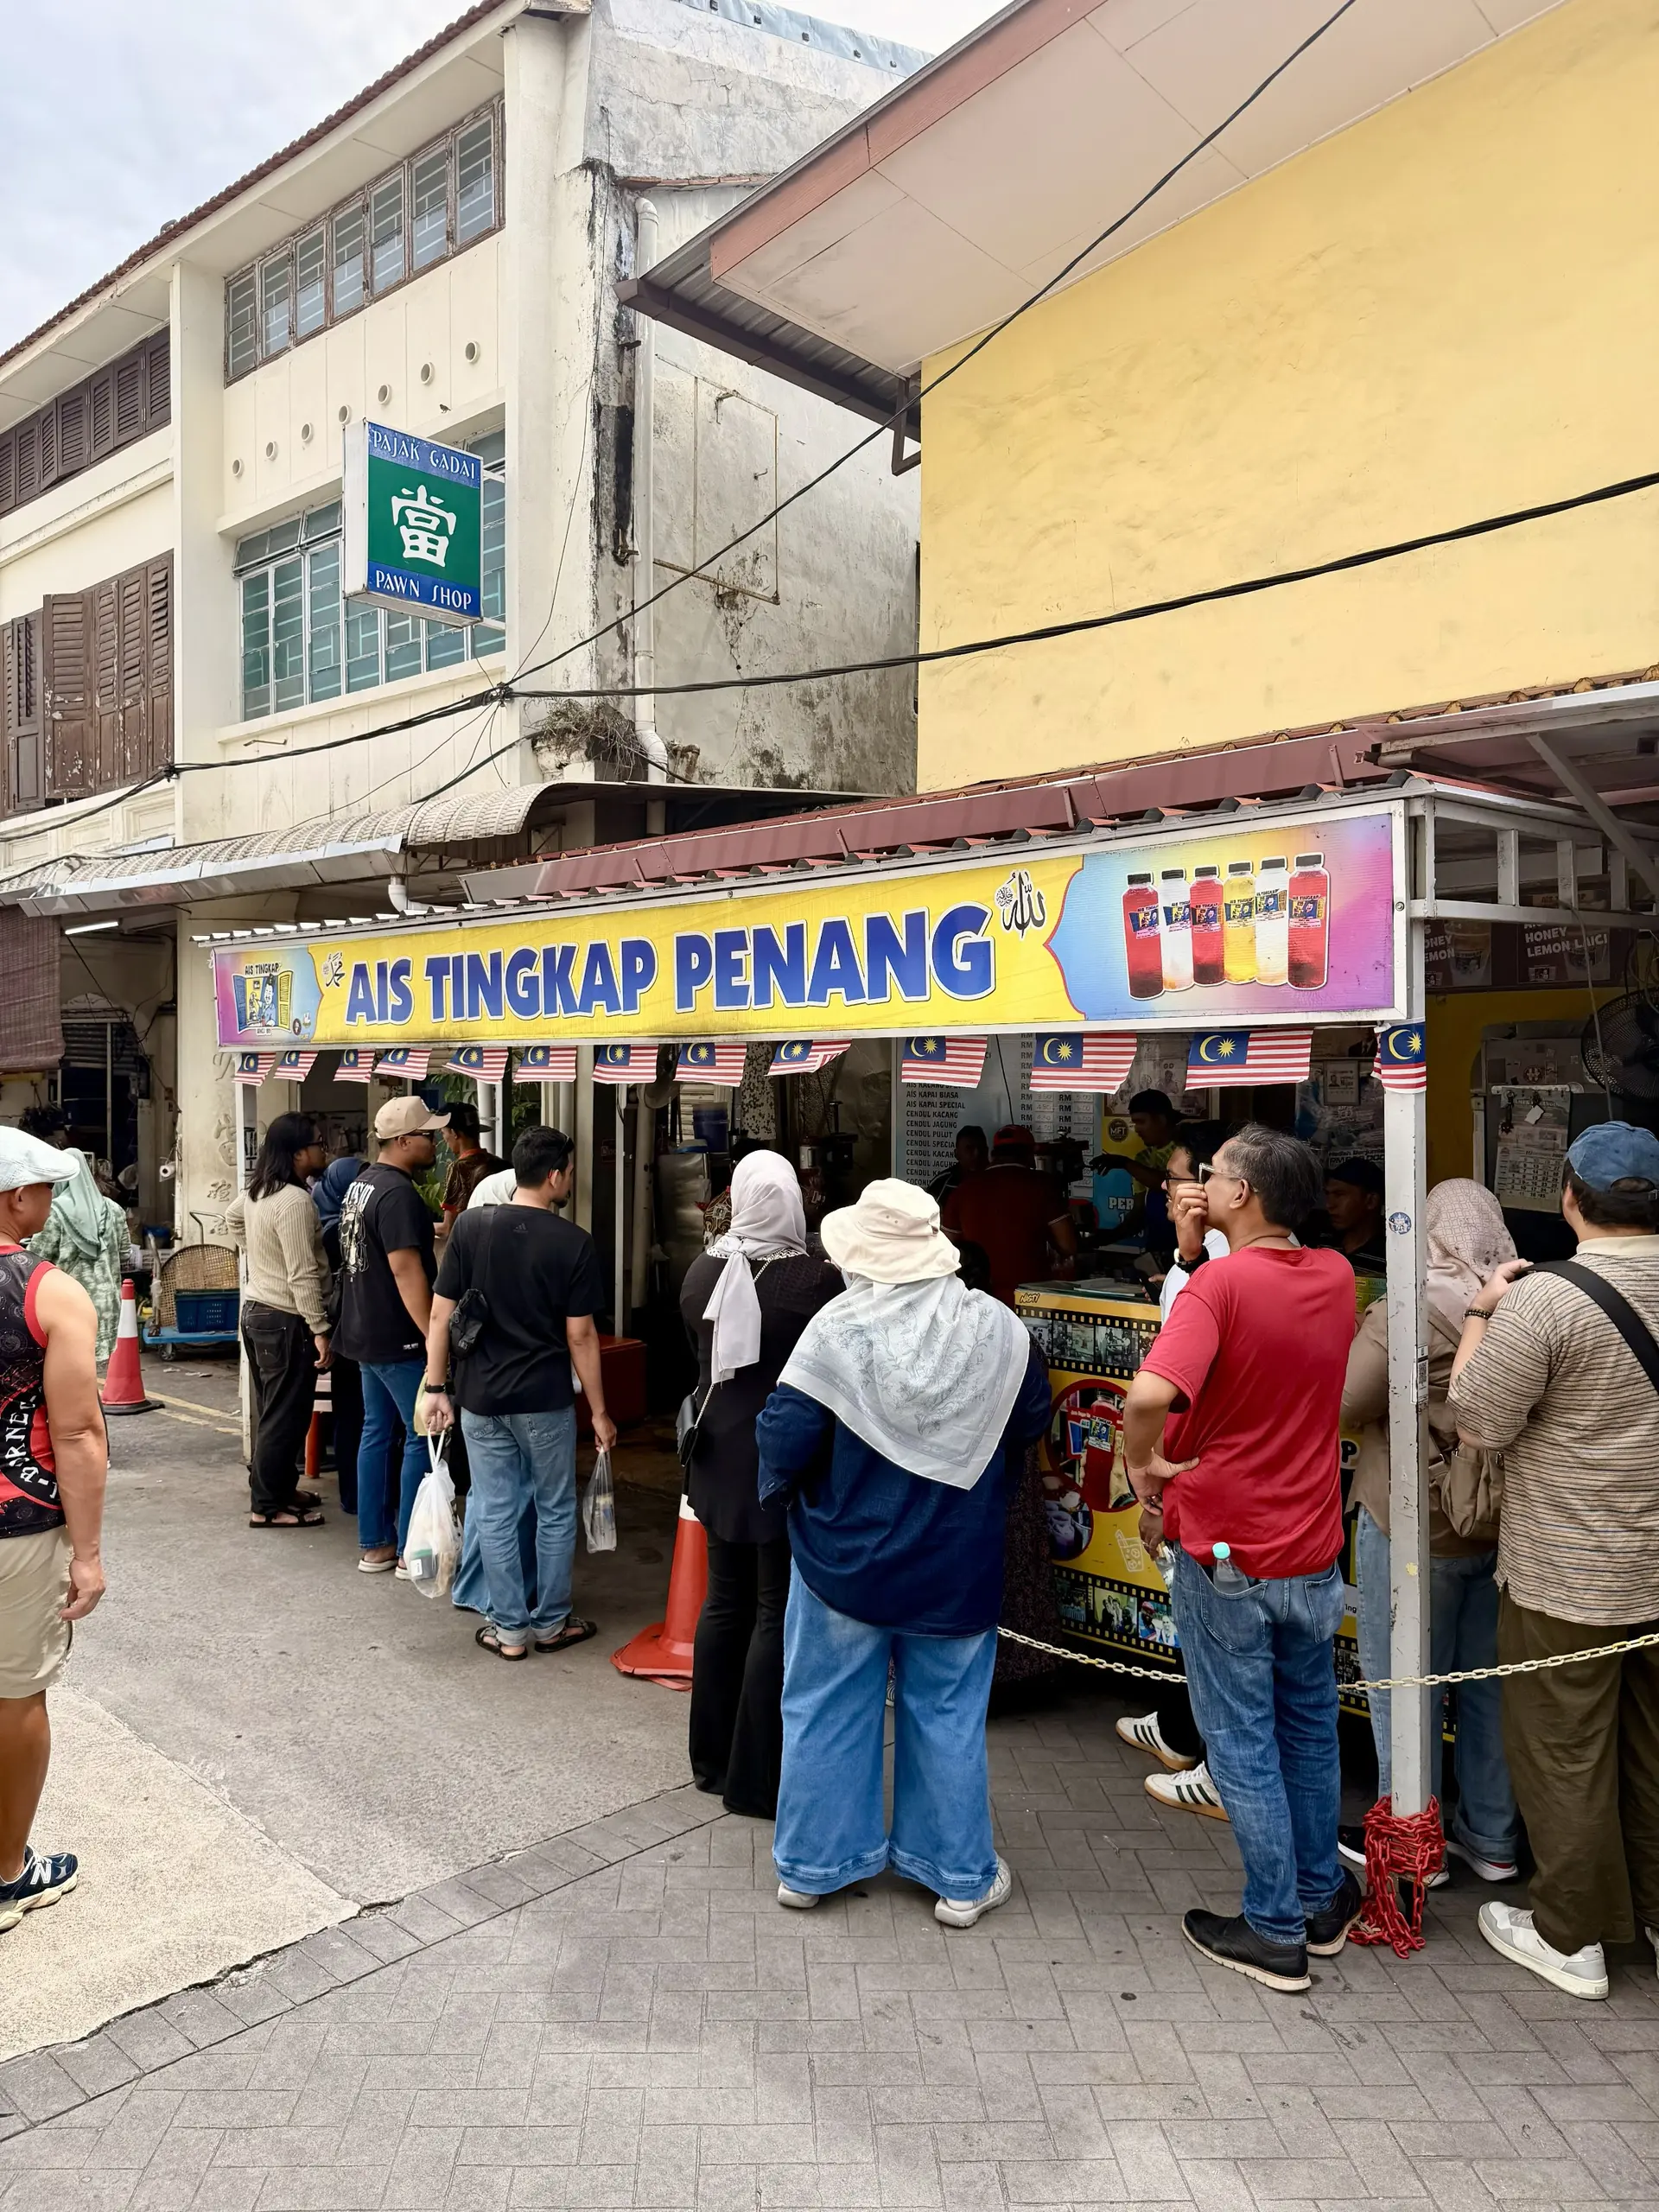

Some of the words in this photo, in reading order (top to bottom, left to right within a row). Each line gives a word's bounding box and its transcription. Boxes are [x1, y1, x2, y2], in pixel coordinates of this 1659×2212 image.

[372, 429, 420, 461] PAJAK
[429, 450, 475, 479] GADAI
[376, 569, 420, 598] PAWN
[431, 585, 472, 609] SHOP
[1425, 934, 1452, 949] ONEY
[1525, 927, 1567, 944] HONEY
[1425, 948, 1455, 963] EMON
[1527, 941, 1571, 957] LEMON
[245, 964, 254, 976] AIS
[255, 963, 279, 975] TINGKAP
[346, 957, 415, 1027] AIS
[424, 936, 658, 1022] TINGKAP
[675, 901, 996, 1014] PENANG
